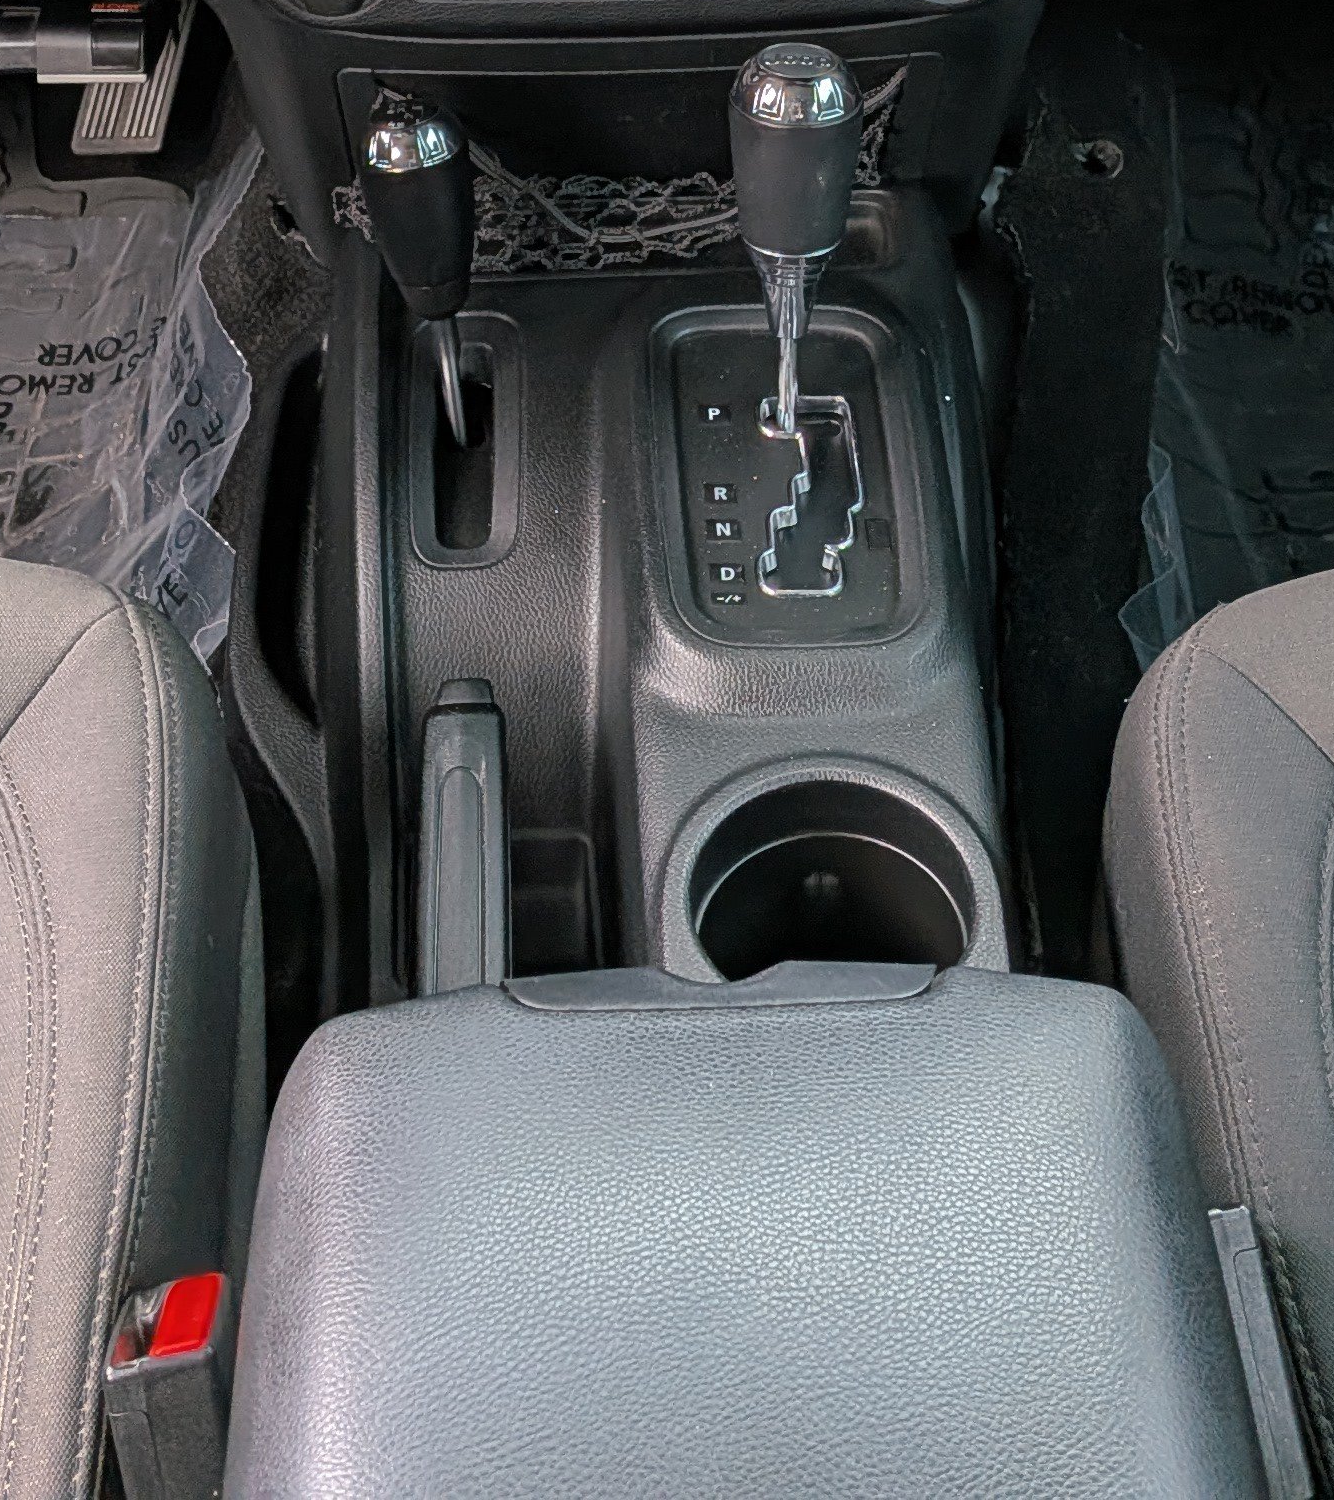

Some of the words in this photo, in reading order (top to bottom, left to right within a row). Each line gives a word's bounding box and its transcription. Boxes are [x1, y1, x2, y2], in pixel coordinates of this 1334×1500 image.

[37, 329, 138, 367] COVER
[708, 408, 720, 421] P
[713, 487, 727, 500] R
[716, 523, 731, 536] N
[720, 567, 735, 581] D
